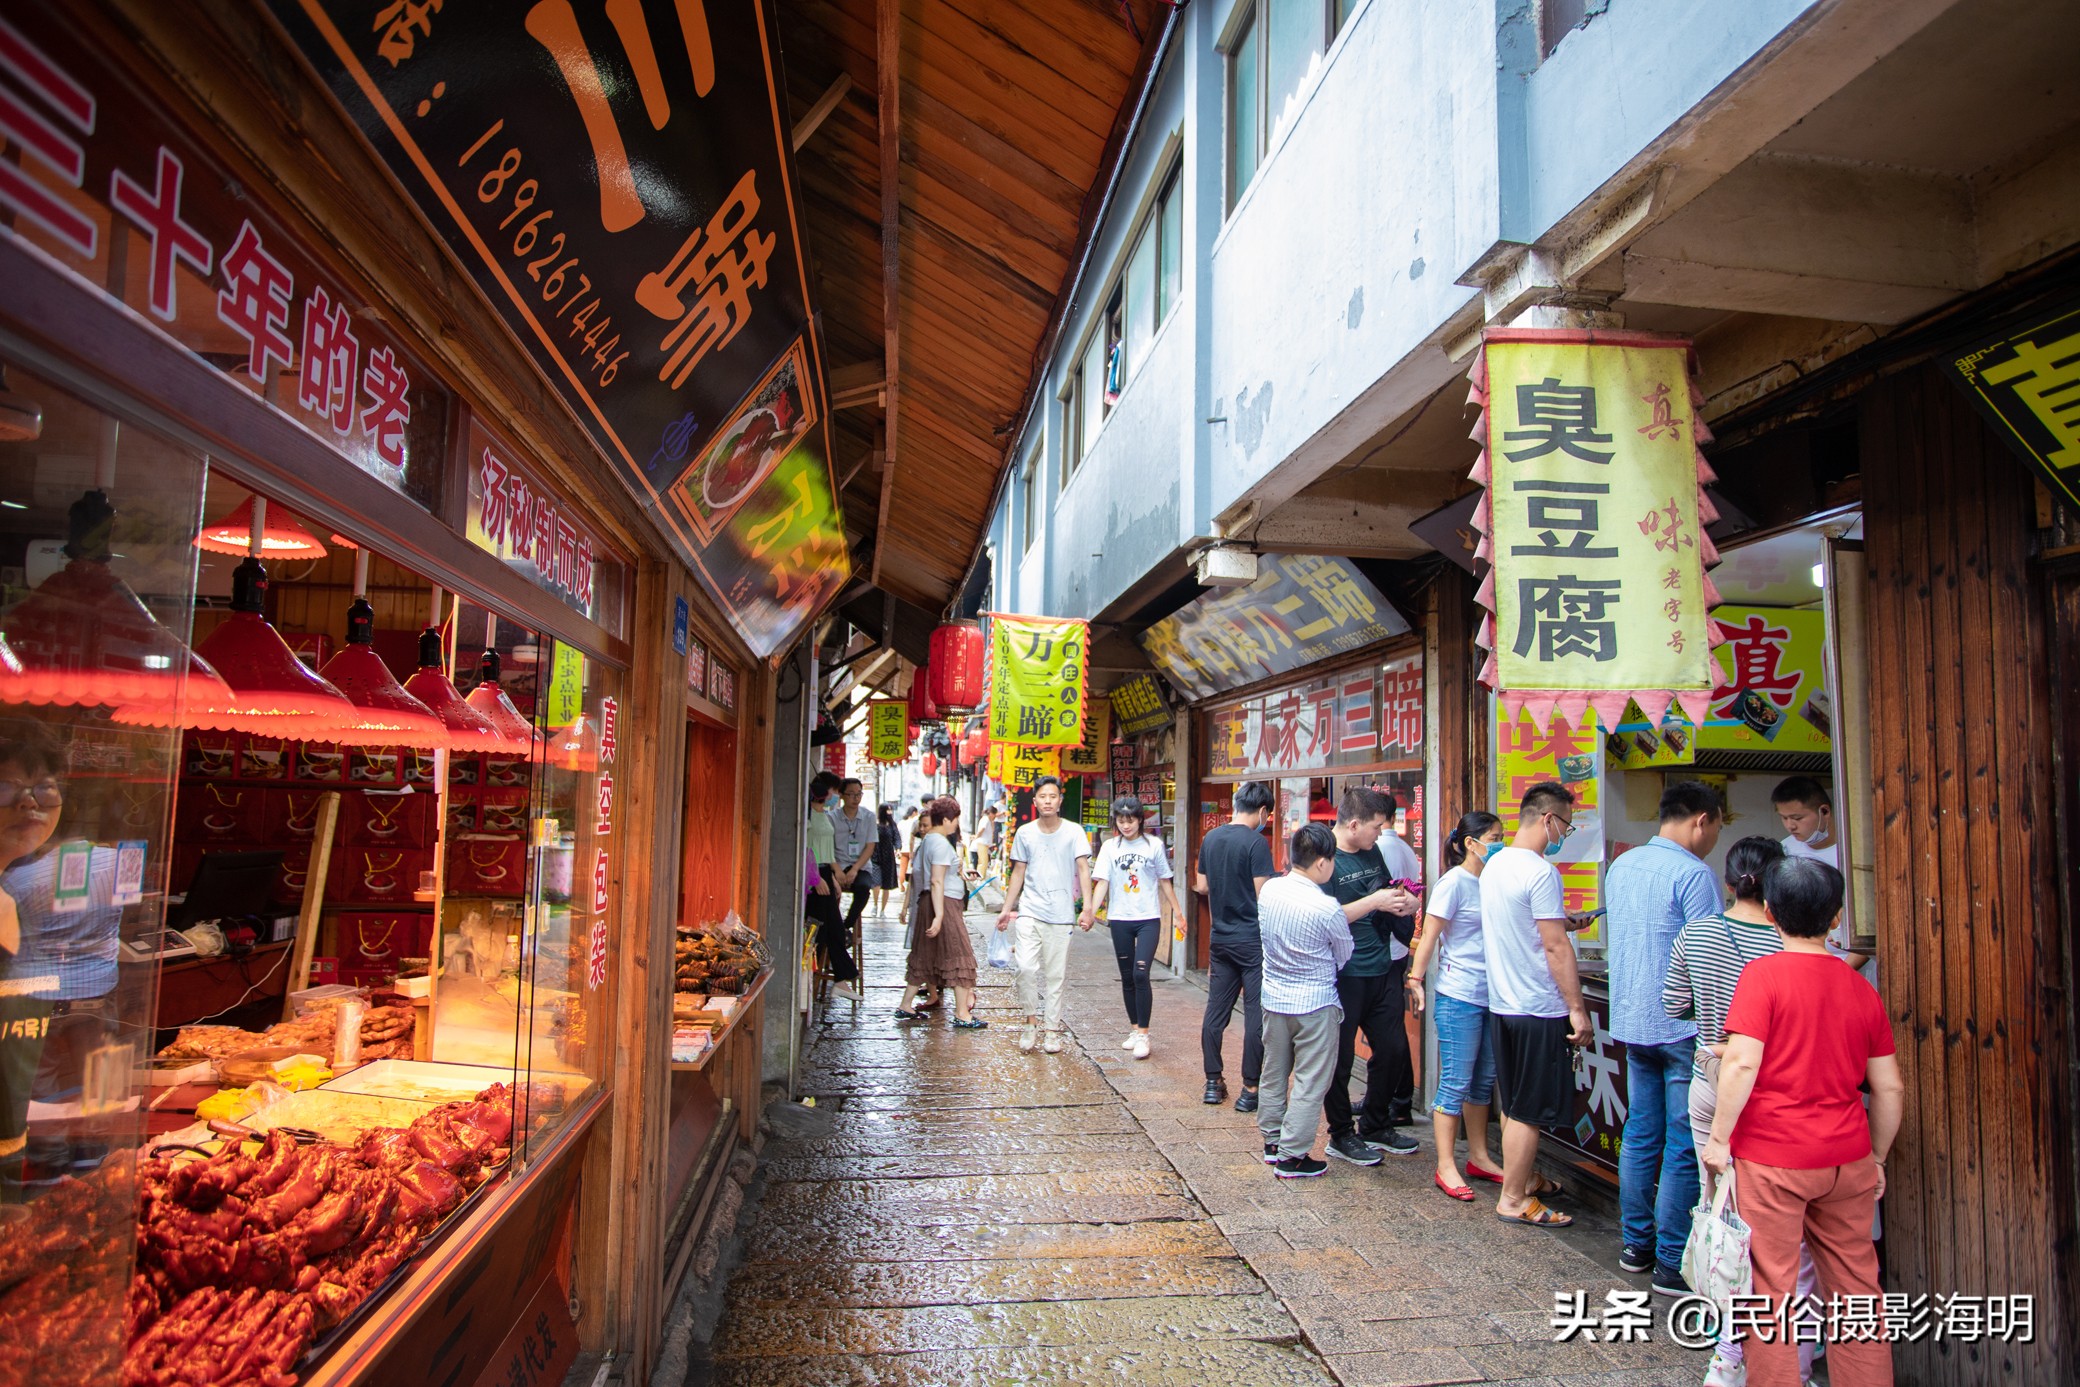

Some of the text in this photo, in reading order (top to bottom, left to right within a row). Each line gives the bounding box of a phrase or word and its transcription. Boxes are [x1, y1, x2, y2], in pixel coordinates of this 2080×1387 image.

[458, 118, 630, 388] 18962674446
[1503, 378, 1623, 662] 臭豆腐
[1637, 383, 1693, 552] 真味
[480, 446, 593, 607] 汤秘制而成
[1663, 569, 1688, 655] 老字号
[880, 706, 902, 755] 臭豆腐
[995, 624, 1011, 738] 2005年定点开业
[1018, 629, 1058, 740] 万三蹄
[1059, 642, 1080, 728] 周庄人家
[1213, 662, 1422, 773] 万三人家万三蹄
[589, 696, 617, 991] 真空包装
[1138, 773, 1159, 805] 底酥
[1115, 853, 1149, 867] MICKEY
